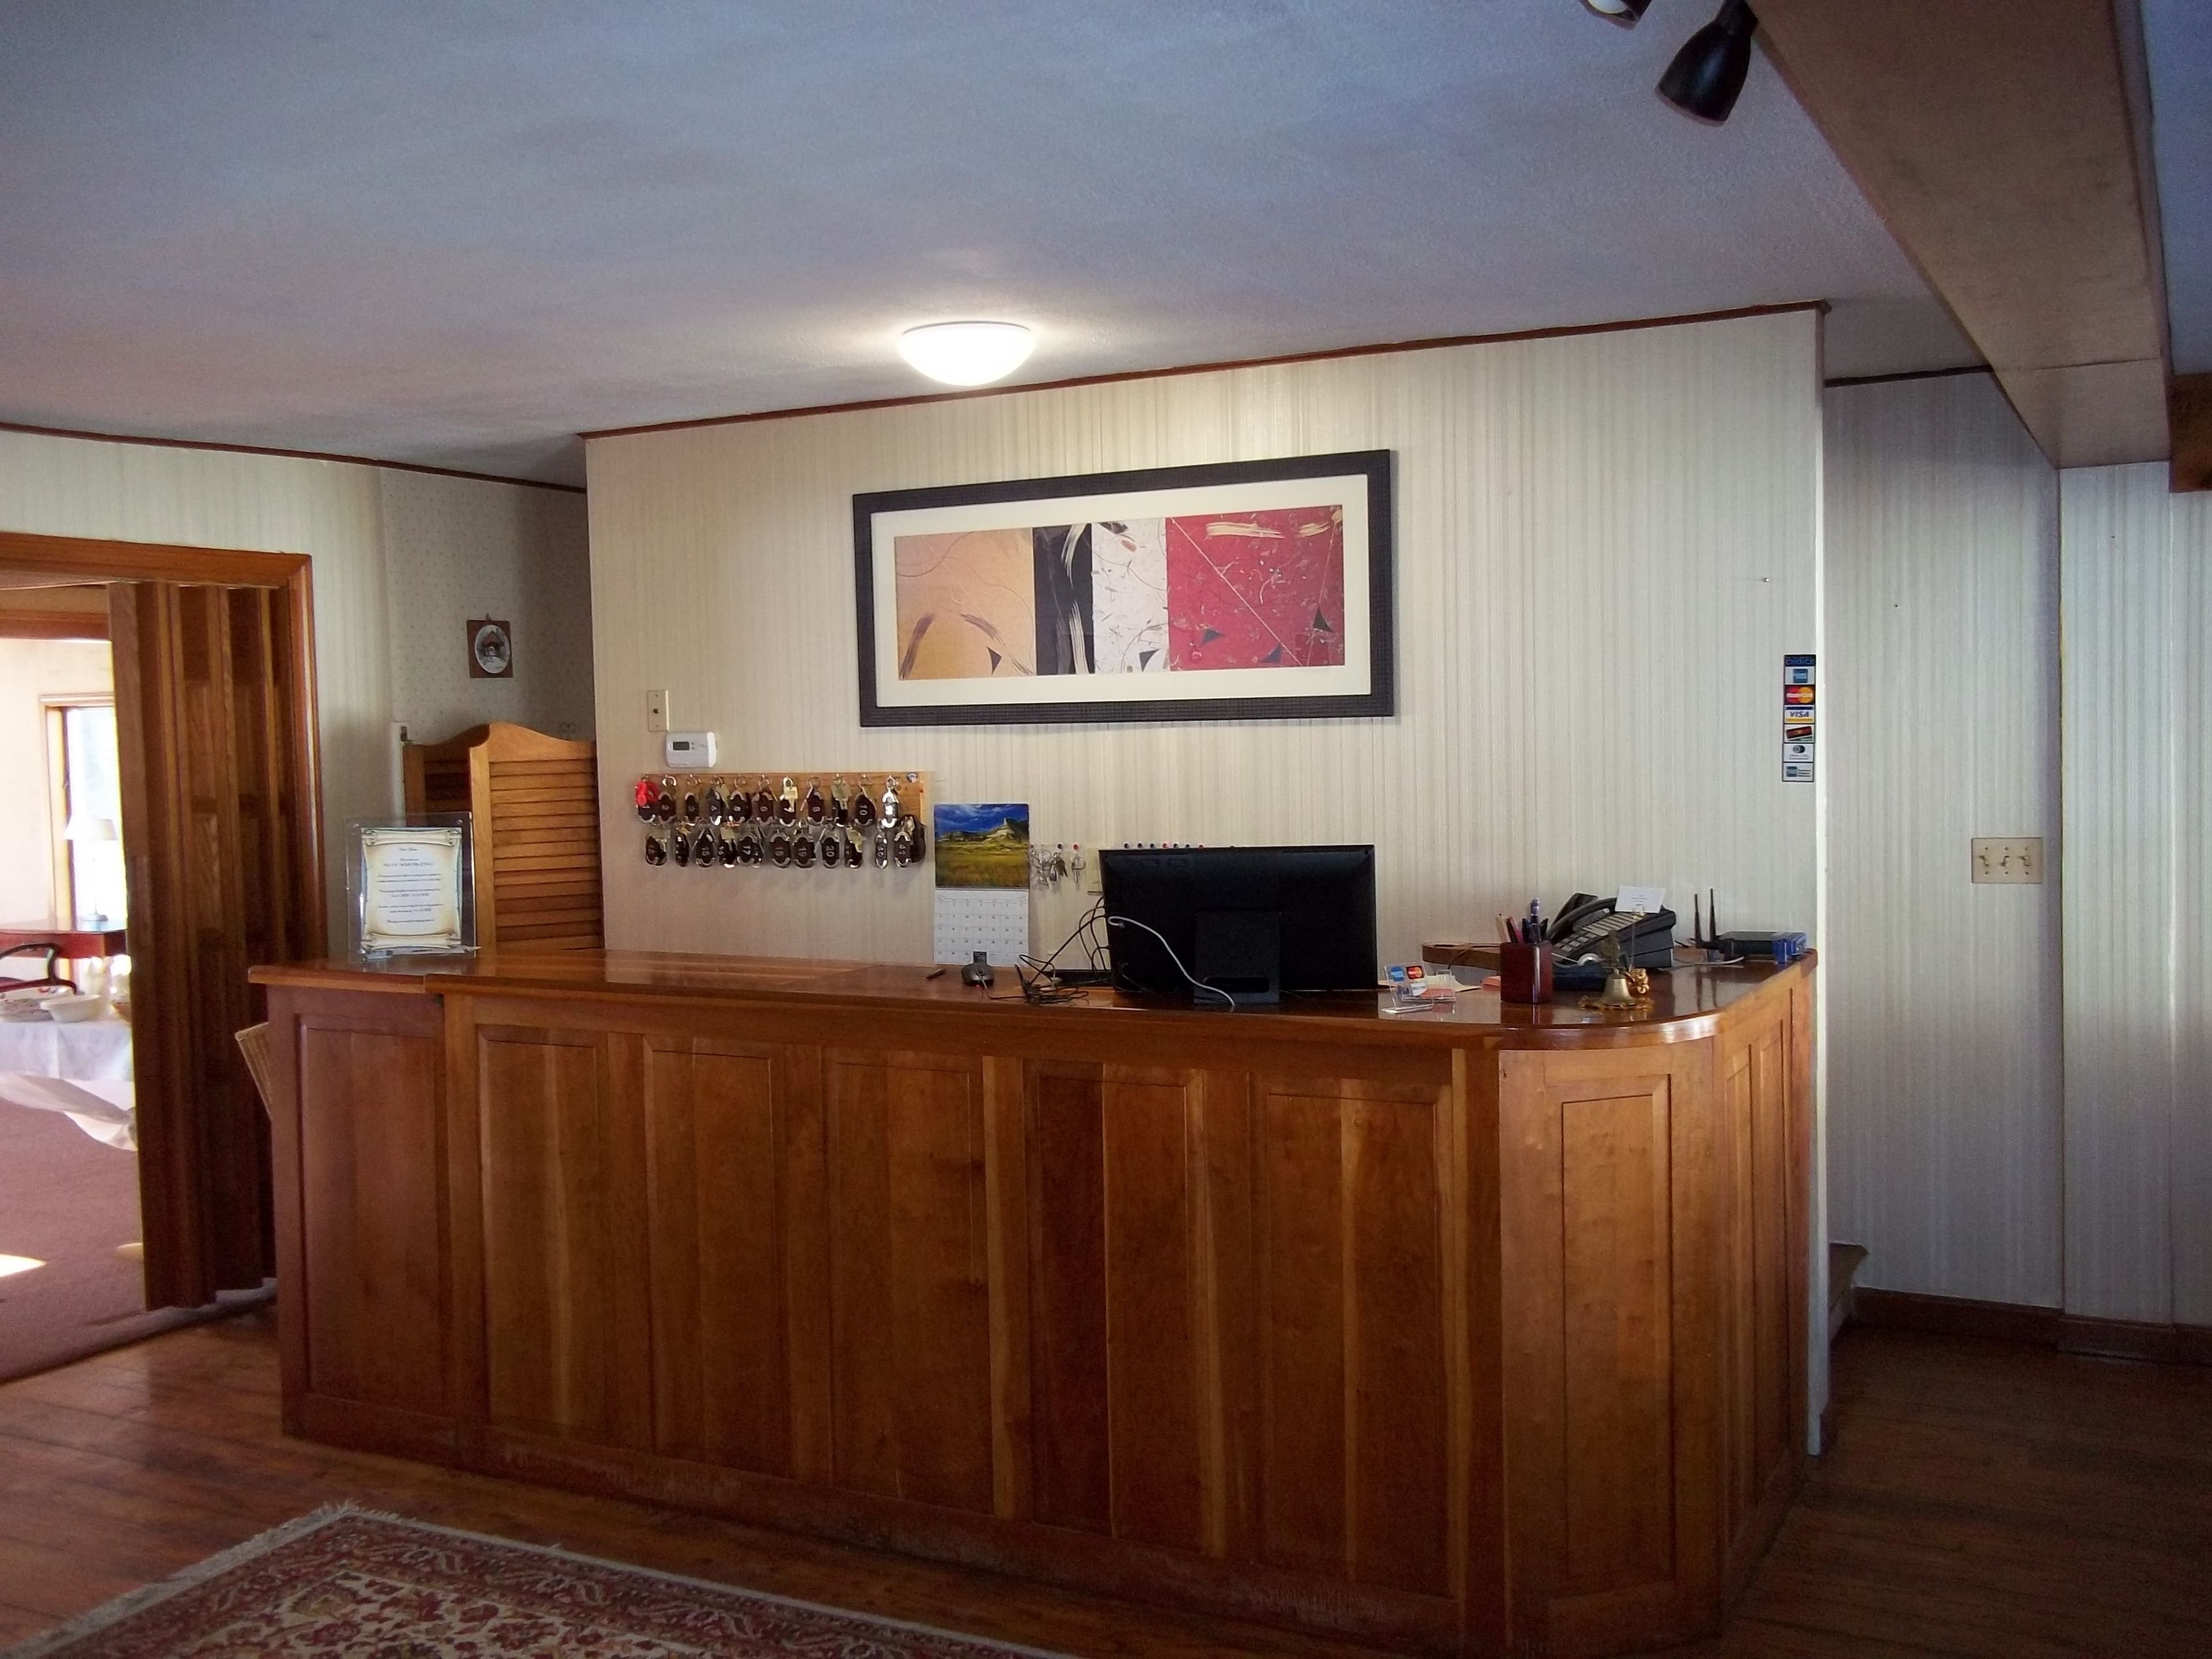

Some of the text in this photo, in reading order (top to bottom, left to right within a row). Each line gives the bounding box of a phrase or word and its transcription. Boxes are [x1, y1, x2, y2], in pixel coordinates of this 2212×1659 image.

[859, 805, 868, 816] 10
[743, 846, 751, 855] 17
[798, 847, 806, 857] 19
[825, 846, 835, 857] 20
